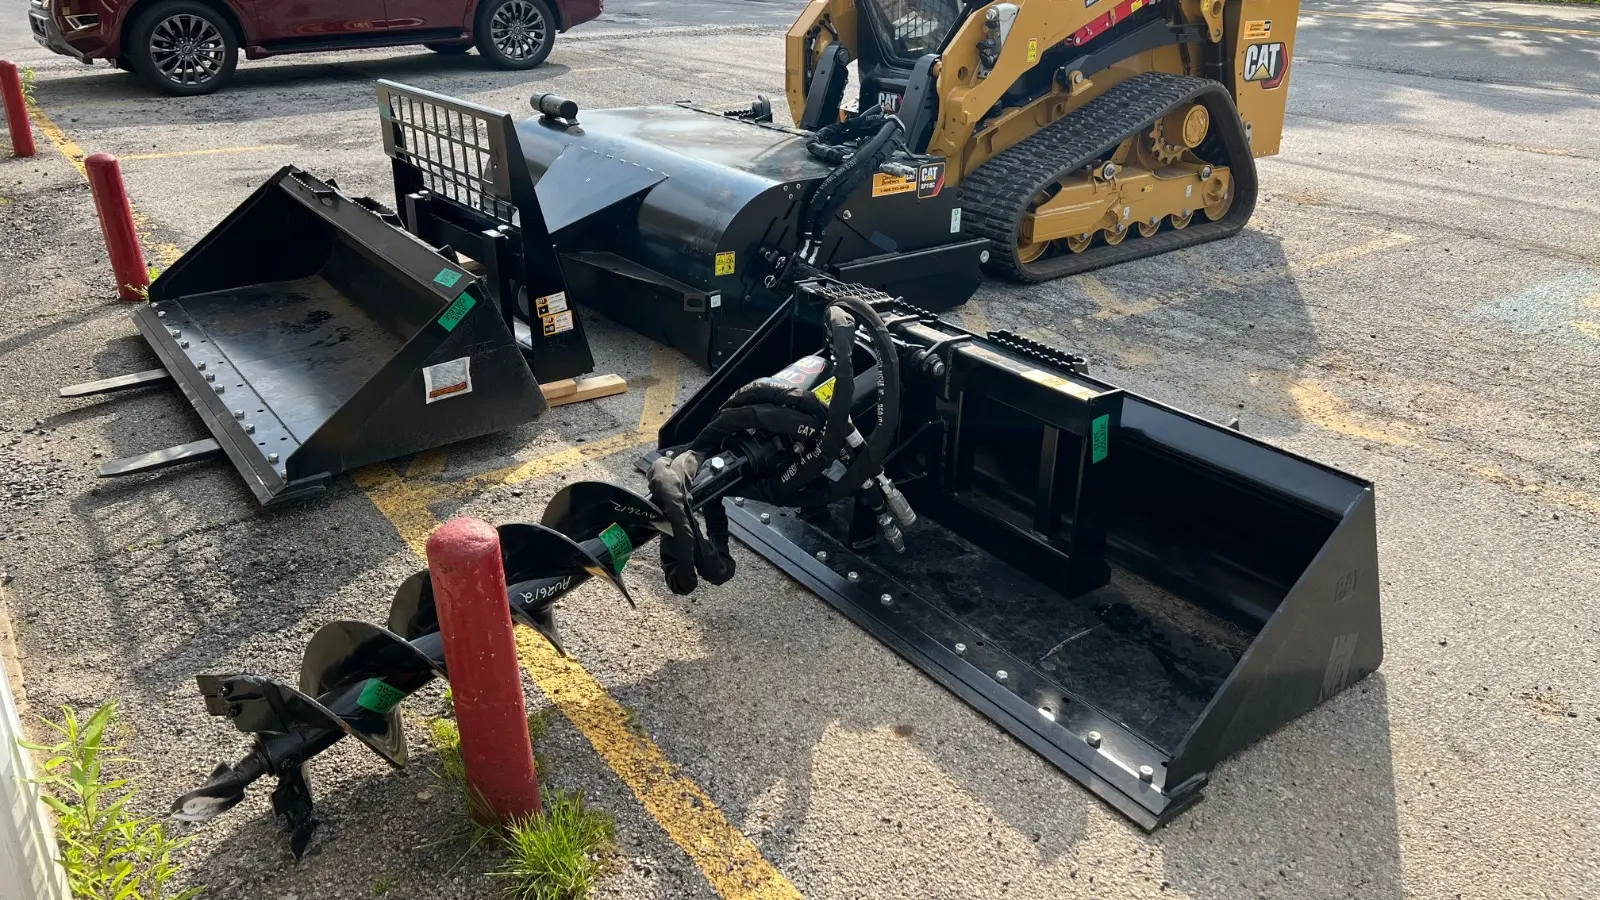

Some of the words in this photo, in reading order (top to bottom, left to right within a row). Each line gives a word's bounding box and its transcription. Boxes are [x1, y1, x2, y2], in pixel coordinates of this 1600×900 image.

[1244, 43, 1281, 80] CAT
[879, 92, 898, 112] CAT
[921, 167, 938, 181] CAT
[444, 298, 466, 321] COLLEGE
[454, 306, 468, 321] STATE
[797, 425, 815, 437] CAT
[610, 500, 657, 519] AU2612
[519, 576, 572, 604] AU2612
